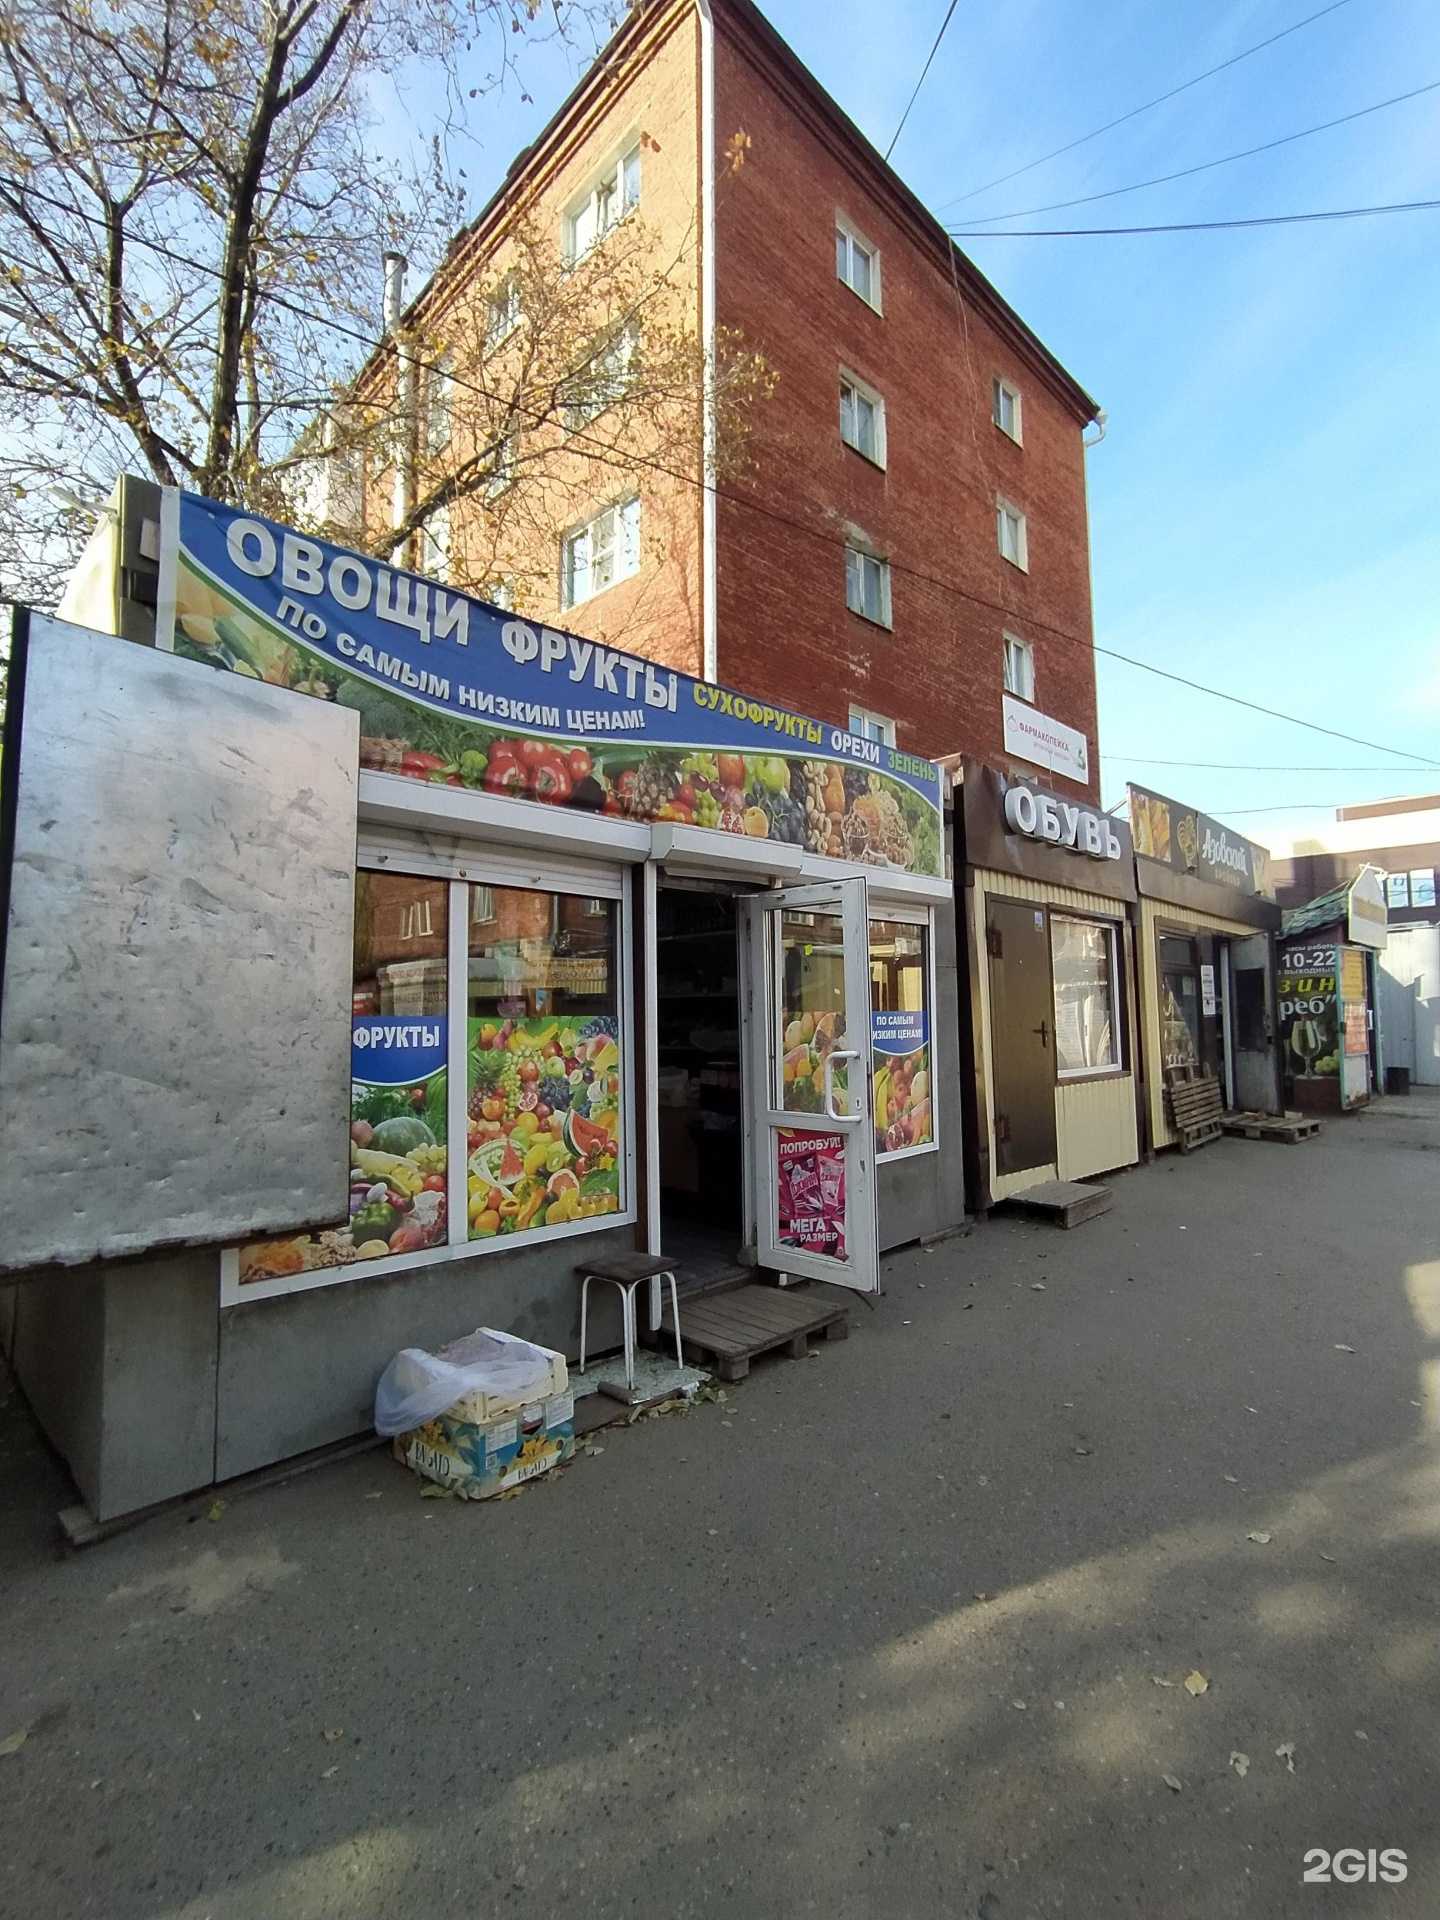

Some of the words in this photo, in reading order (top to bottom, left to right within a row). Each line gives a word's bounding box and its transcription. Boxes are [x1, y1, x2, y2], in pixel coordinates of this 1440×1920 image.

[226, 518, 469, 646] ОВОЩИ
[501, 620, 678, 712] ФРУКТЫ
[692, 683, 823, 745] СУХОФРУКТЫ
[830, 730, 880, 764] ОРЕХИ
[887, 753, 937, 783] ЗЕЛЕНЬ
[276, 596, 327, 639] ПО
[336, 633, 450, 701] САМЫМ
[458, 685, 561, 729] НИЗКИМ
[566, 709, 647, 734] ЦЕНАМ!
[1005, 786, 1121, 860] ОБУВЬ
[1282, 950, 1336, 968] 10-22
[876, 1015, 887, 1026] ПО
[888, 1015, 914, 1025] САМЫМ
[352, 1026, 440, 1048] ФРУКТЫ
[871, 1029, 897, 1041] ИЗКИМ
[780, 1136, 842, 1154] ПОПРОБУЙ!
[790, 1217, 827, 1233] МЕГА
[800, 1232, 839, 1243] РАЗМЕР
